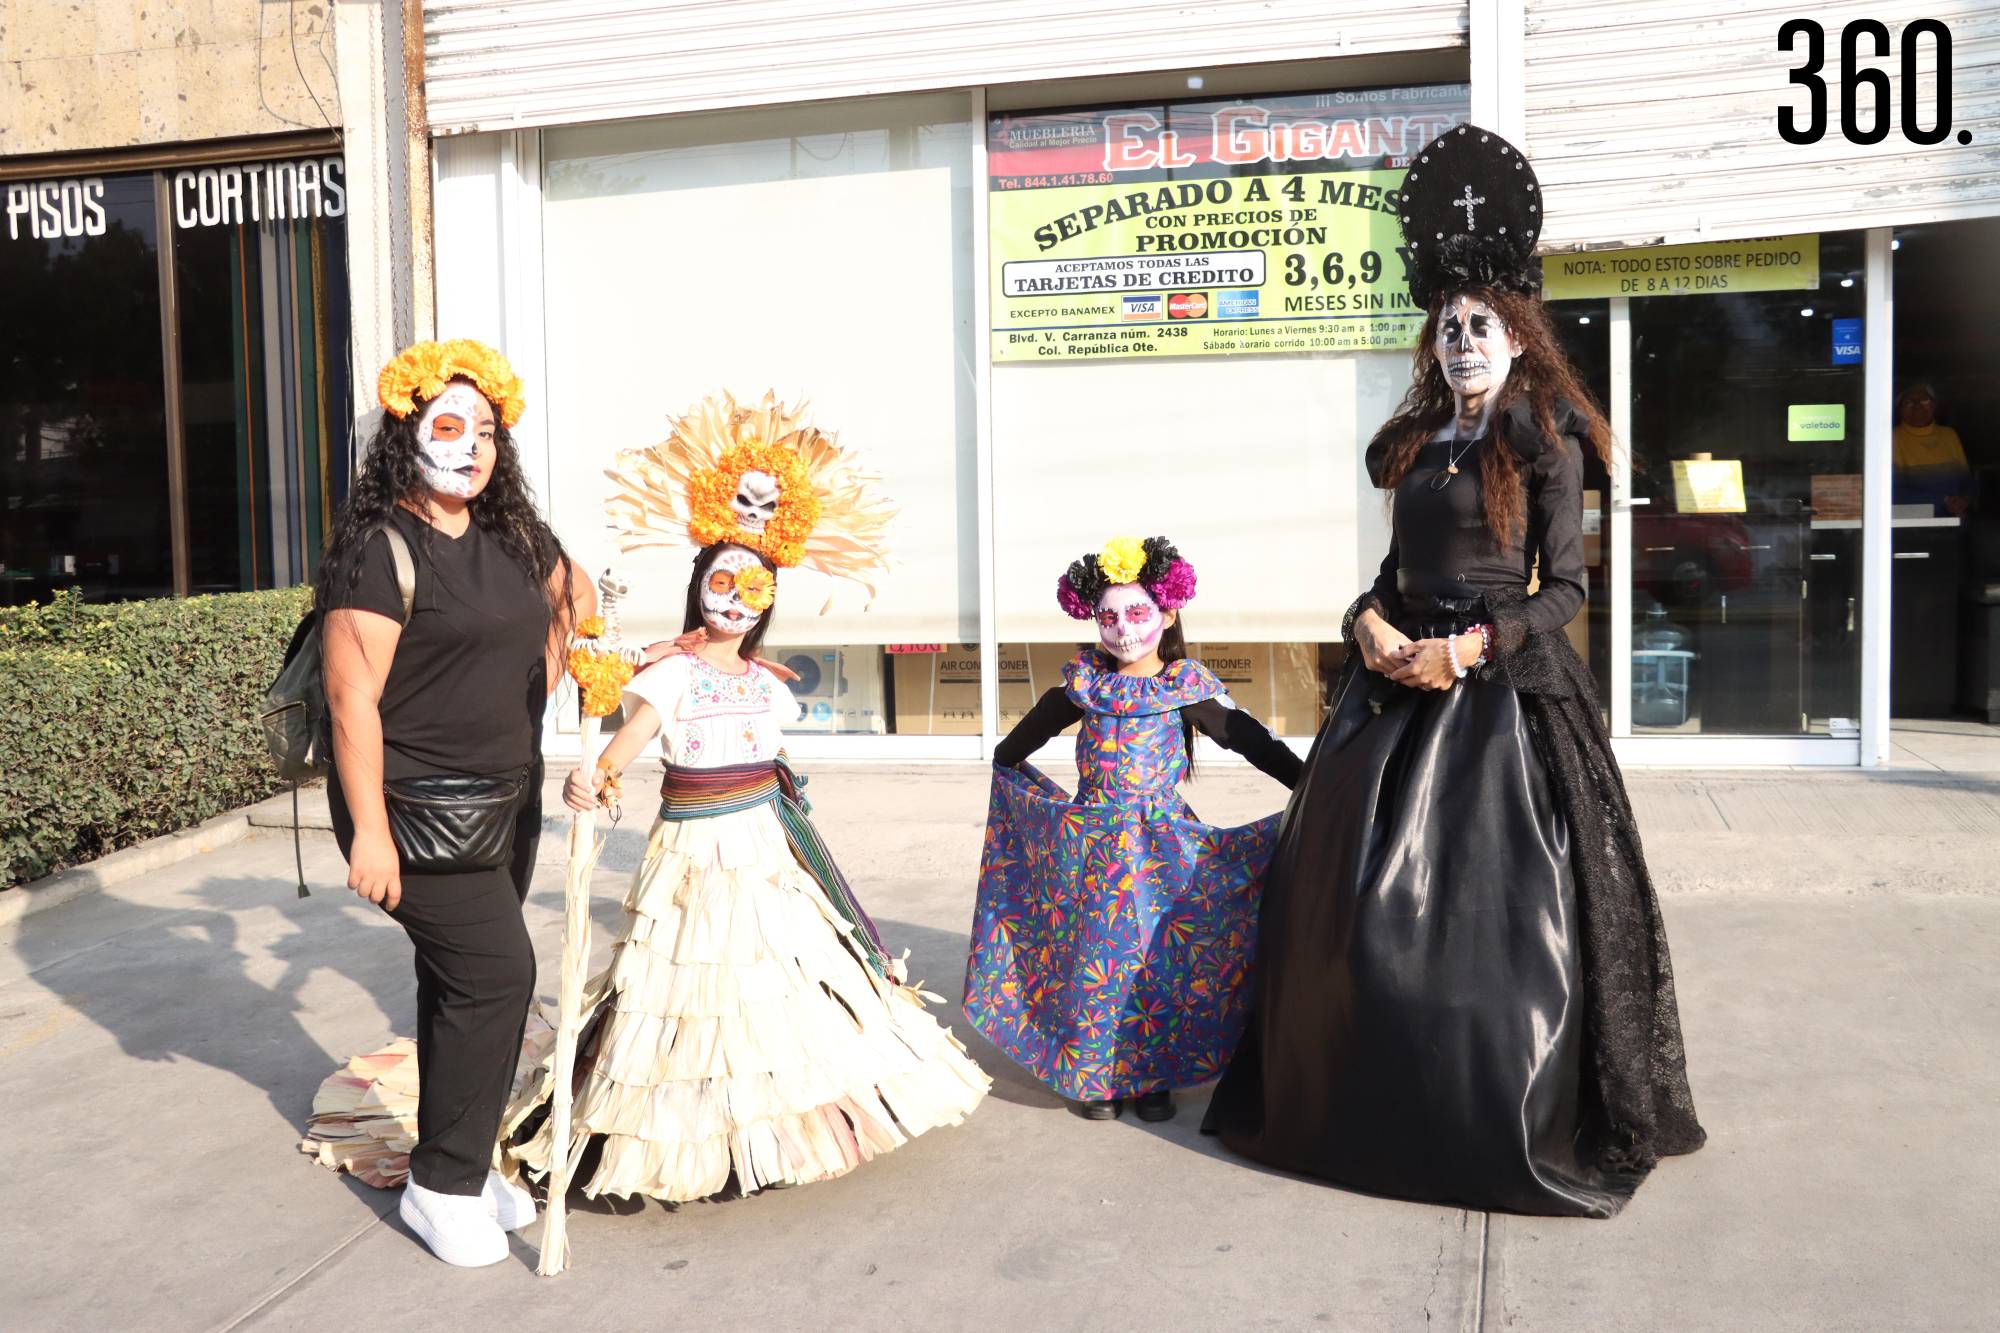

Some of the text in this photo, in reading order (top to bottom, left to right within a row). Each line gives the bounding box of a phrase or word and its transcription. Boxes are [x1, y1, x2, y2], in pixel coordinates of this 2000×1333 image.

[1335, 91, 1386, 104] Somos
[1010, 125, 1096, 141] MUEBLERIA
[1009, 136, 1097, 149] Calidad al Mejor Precio
[999, 172, 1113, 190] Tel. 844.1.41.78.60
[175, 157, 346, 229] CORTINAS
[7, 178, 106, 240] PISOS
[1034, 179, 1232, 252] SEPARADO
[1244, 178, 1270, 202] A
[1281, 176, 1305, 202] 4
[1145, 208, 1317, 229] CON PRECIOS DE
[1136, 222, 1328, 252] PROMOCIÓN
[1055, 257, 1210, 273] ACEPTAMOS TODAS LAS
[1284, 250, 1383, 291] 3,6,9
[1563, 251, 1801, 276] NOTA: TODO ESTO SOBRE PEDIDO
[1014, 268, 1255, 293] TARJETAS DE CREDITO
[1620, 274, 1728, 293] DE 8 A 12 DIAS
[1130, 302, 1155, 313] VISA
[1285, 294, 1347, 312] MESES
[1353, 293, 1383, 309] SIN
[1010, 306, 1116, 319] EXCEPTO BANAMEX
[1009, 327, 1188, 344] Blvd. V. Carranza núm. 2438
[1213, 328, 1248, 337] Horario:
[1249, 327, 1275, 336] Lunes
[1284, 325, 1317, 334] Viernes
[1319, 324, 1340, 333] 9:30
[1341, 325, 1355, 333] am
[1370, 323, 1390, 332] 1:00
[1391, 323, 1406, 333] pm
[1038, 342, 1158, 357] Col. República Ote.
[1203, 340, 1236, 350] Sábado
[1274, 338, 1305, 348] corrido
[1310, 337, 1335, 347] 10:00
[1337, 338, 1351, 346] am
[1361, 336, 1381, 345] 5:00
[1383, 337, 1398, 346] pm
[1833, 345, 1861, 355] VISA
[940, 660, 957, 671] AIR
